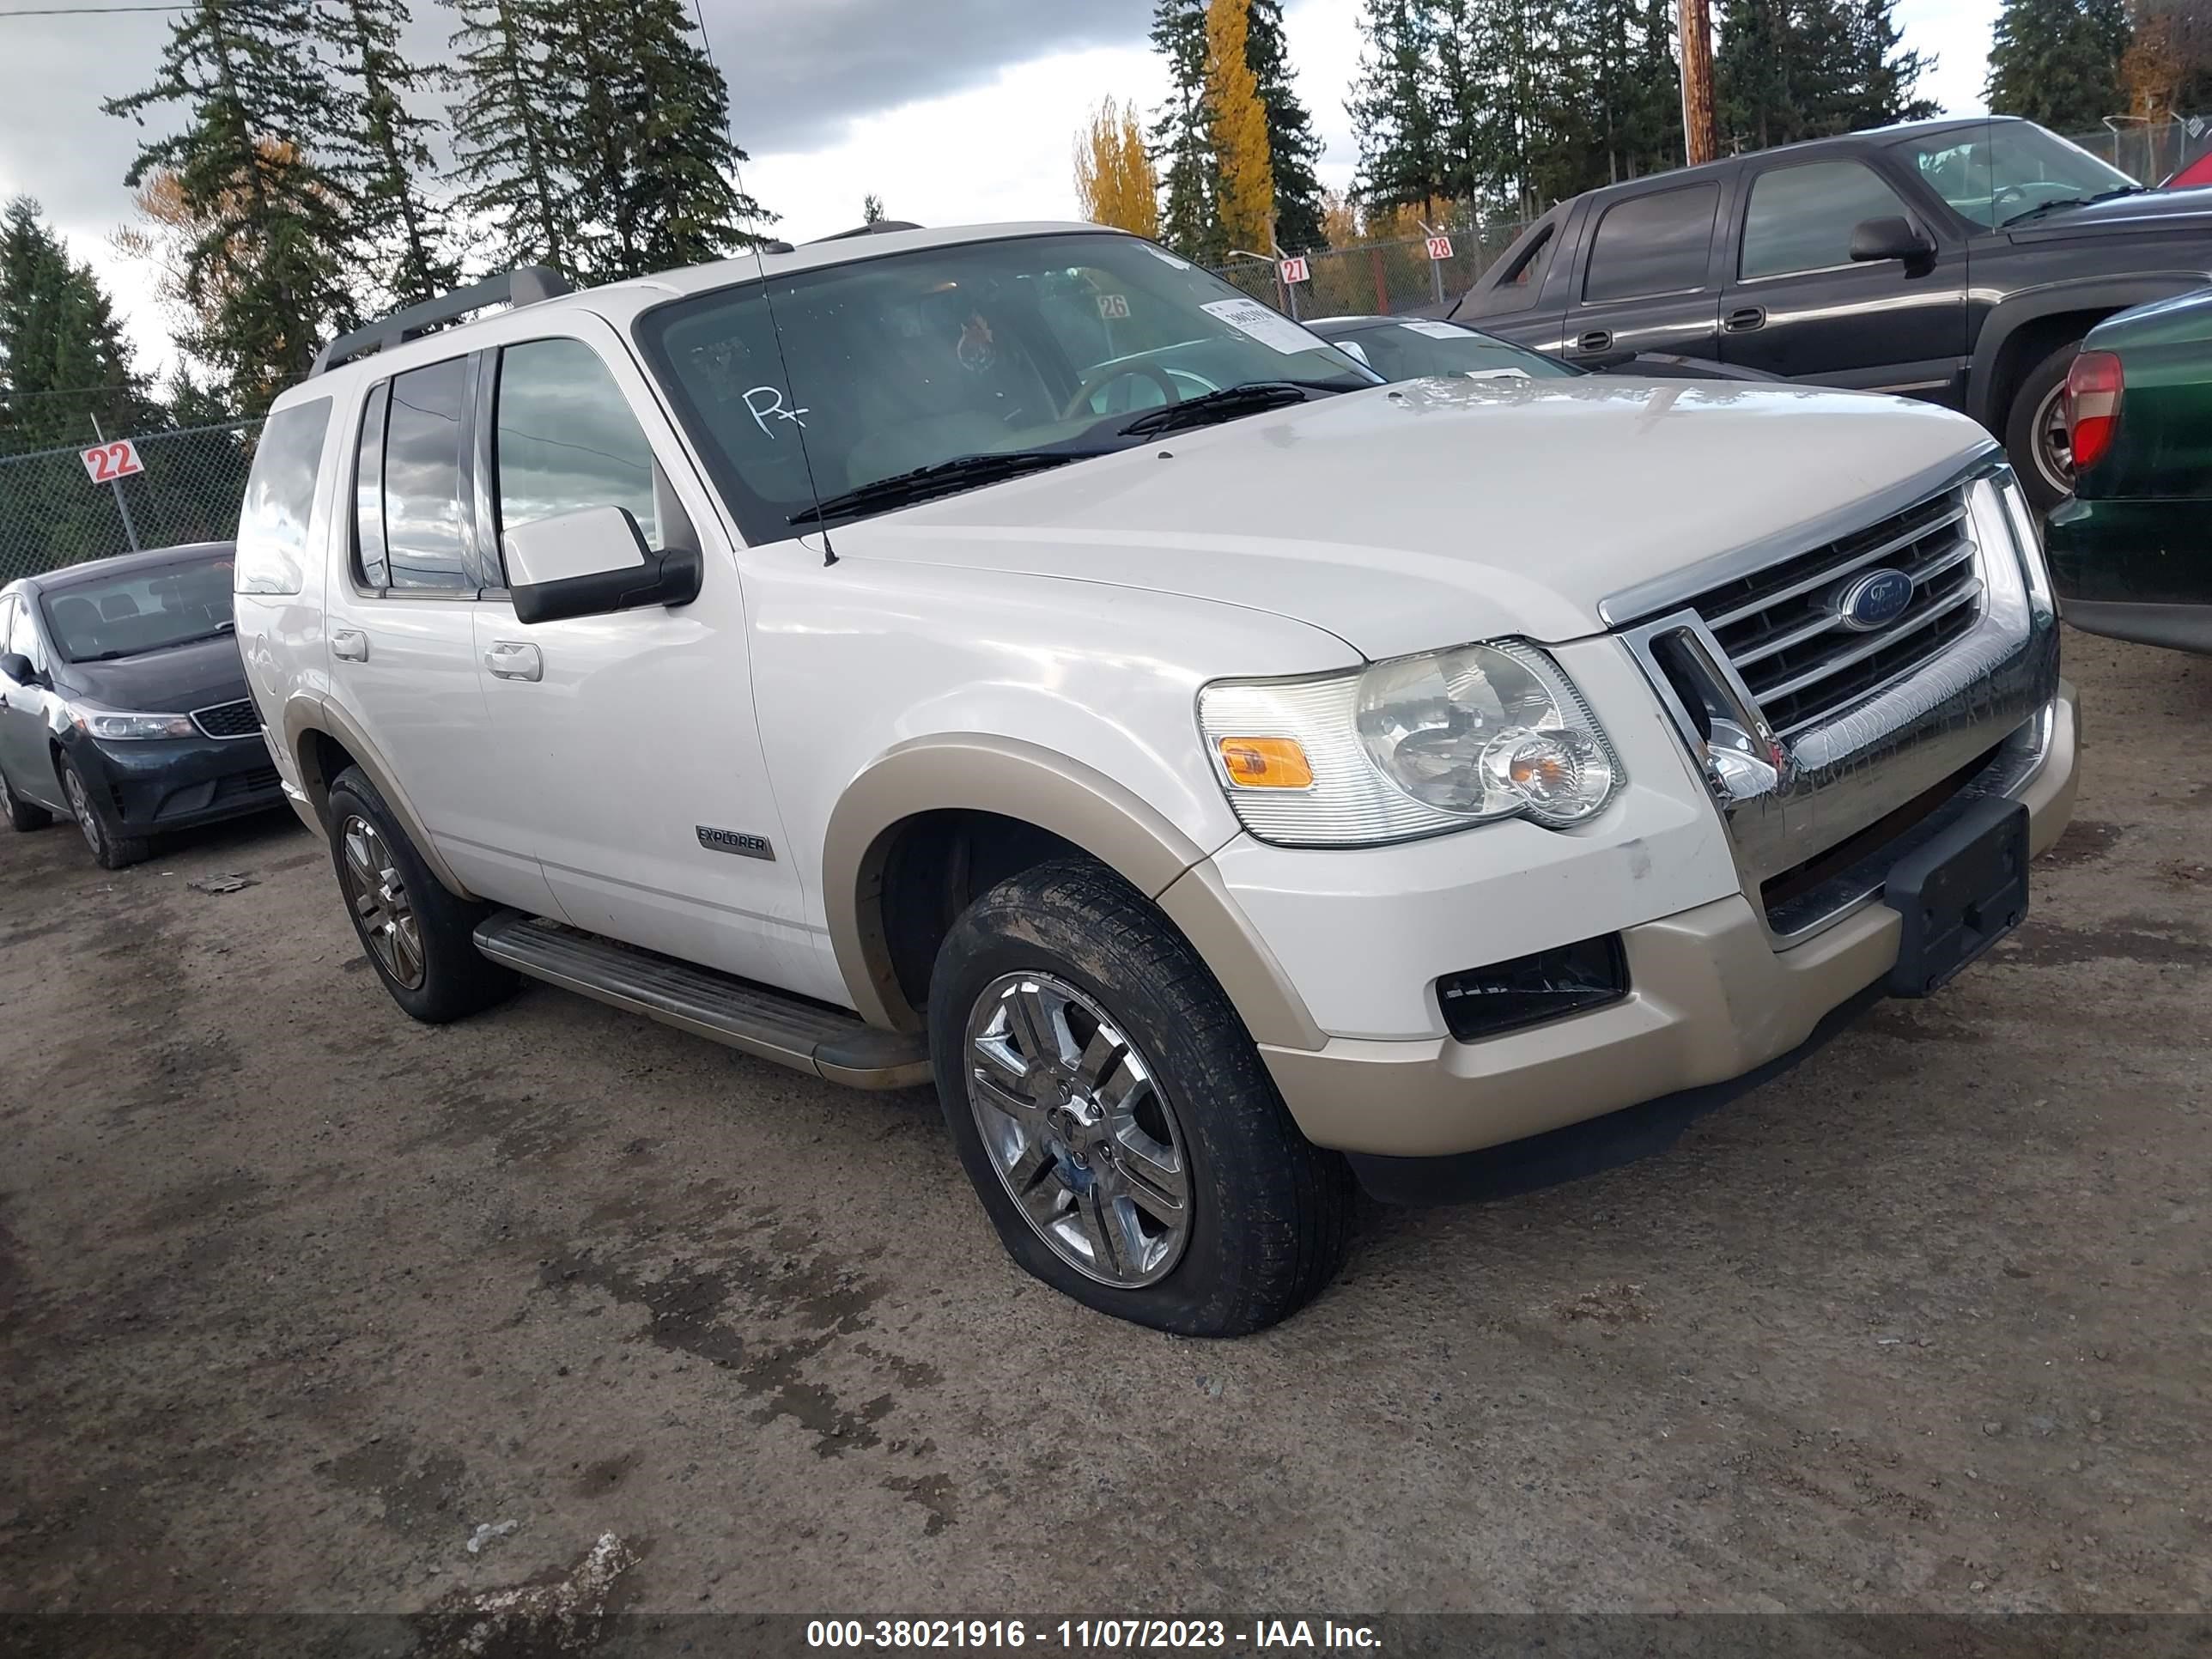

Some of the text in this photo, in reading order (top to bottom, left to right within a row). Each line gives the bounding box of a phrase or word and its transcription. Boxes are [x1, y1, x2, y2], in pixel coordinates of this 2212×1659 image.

[1429, 238, 1450, 258] 28
[1284, 259, 1304, 282] 27
[1100, 295, 1127, 317] 26
[88, 443, 138, 481] 22
[698, 829, 767, 845] EXPLORER
